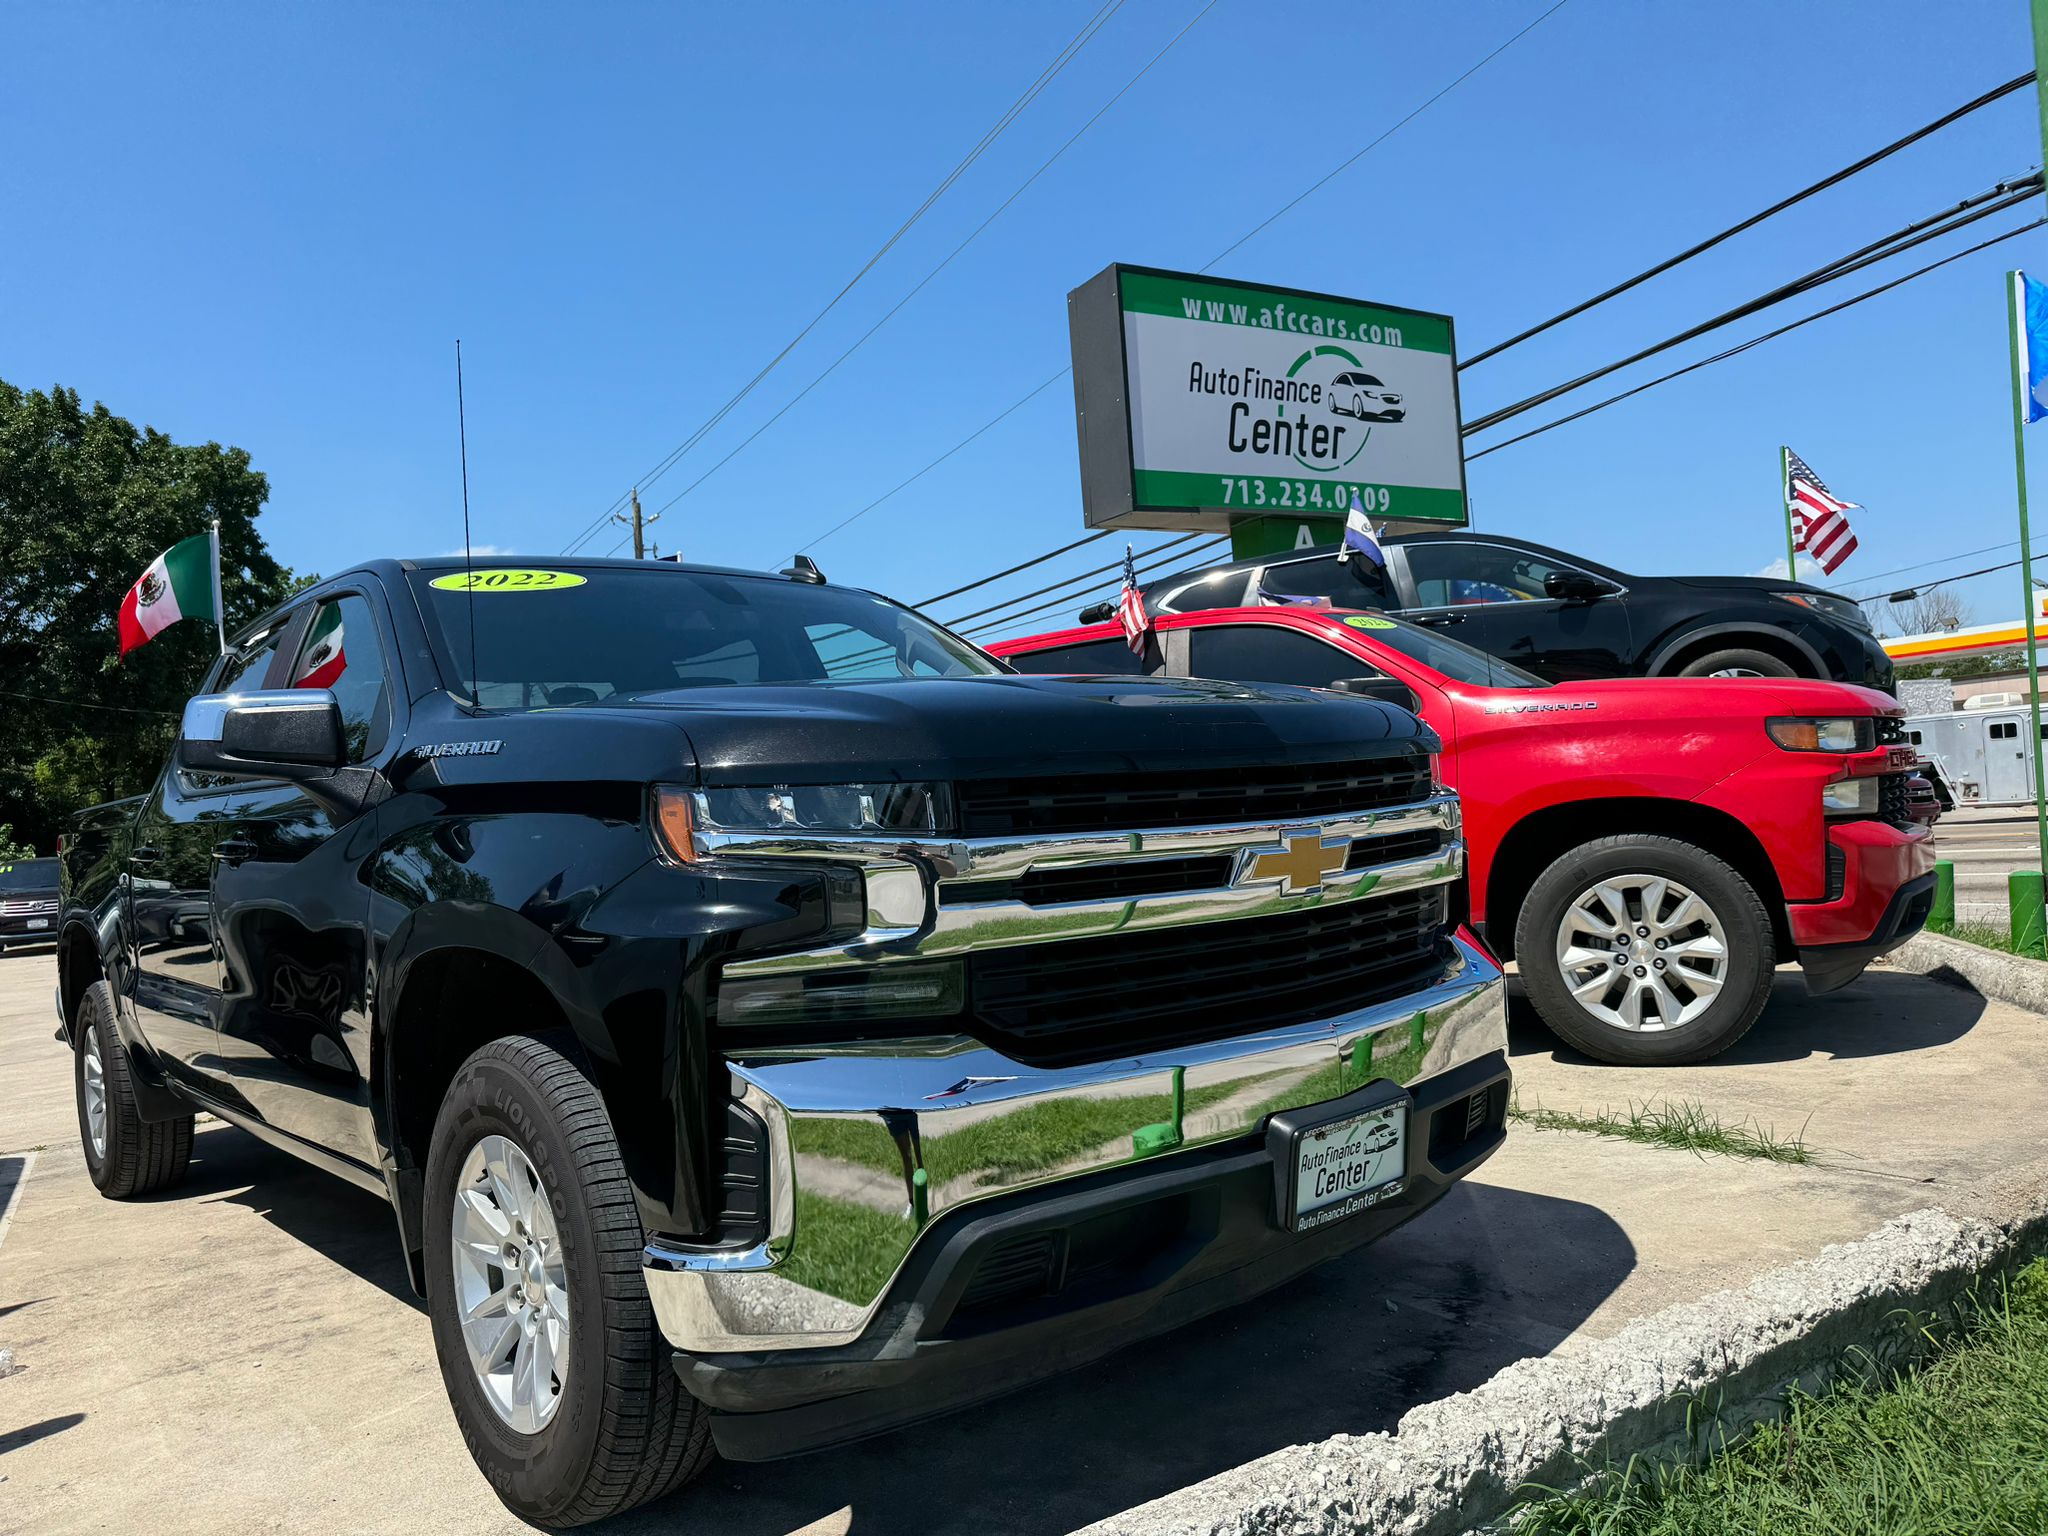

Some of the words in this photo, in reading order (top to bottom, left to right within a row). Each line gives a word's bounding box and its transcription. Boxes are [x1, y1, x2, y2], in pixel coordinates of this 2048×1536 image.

[1181, 297, 1403, 347] www.afccars.com
[1228, 401, 1347, 460] Center
[1221, 478, 1390, 512] 713.234.009
[458, 573, 557, 588] 2022
[1315, 1160, 1371, 1198] Center
[1345, 1191, 1379, 1215] Center
